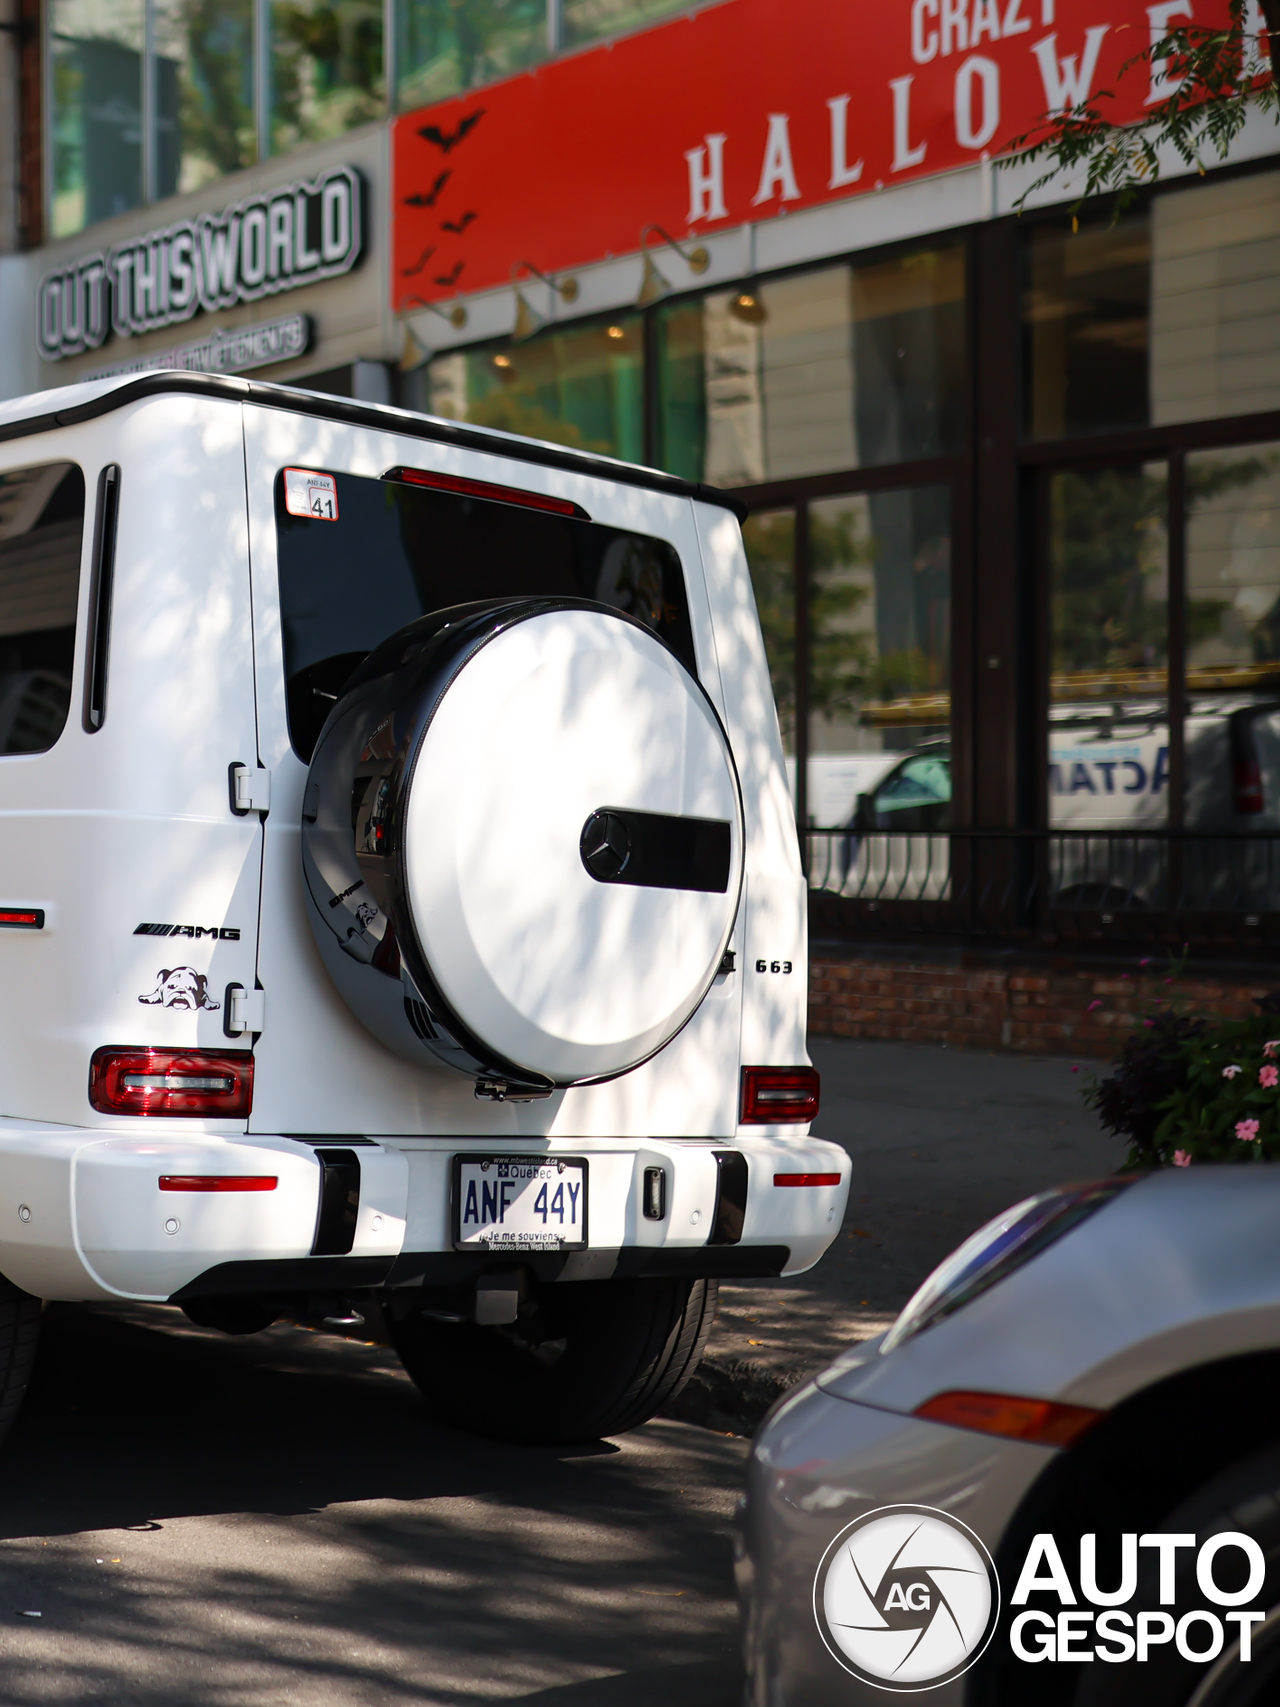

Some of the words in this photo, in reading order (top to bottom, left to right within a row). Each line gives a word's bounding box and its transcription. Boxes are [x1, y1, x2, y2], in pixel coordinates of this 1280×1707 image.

[41, 263, 106, 350] OUT
[113, 231, 194, 330] THIS
[311, 496, 333, 519] 41
[510, 1165, 552, 1179] Québec
[463, 1179, 515, 1224] ANF
[533, 1181, 581, 1225] 44Y
[488, 1230, 499, 1241] Je
[501, 1231, 516, 1241] me
[517, 1230, 559, 1241] souviens
